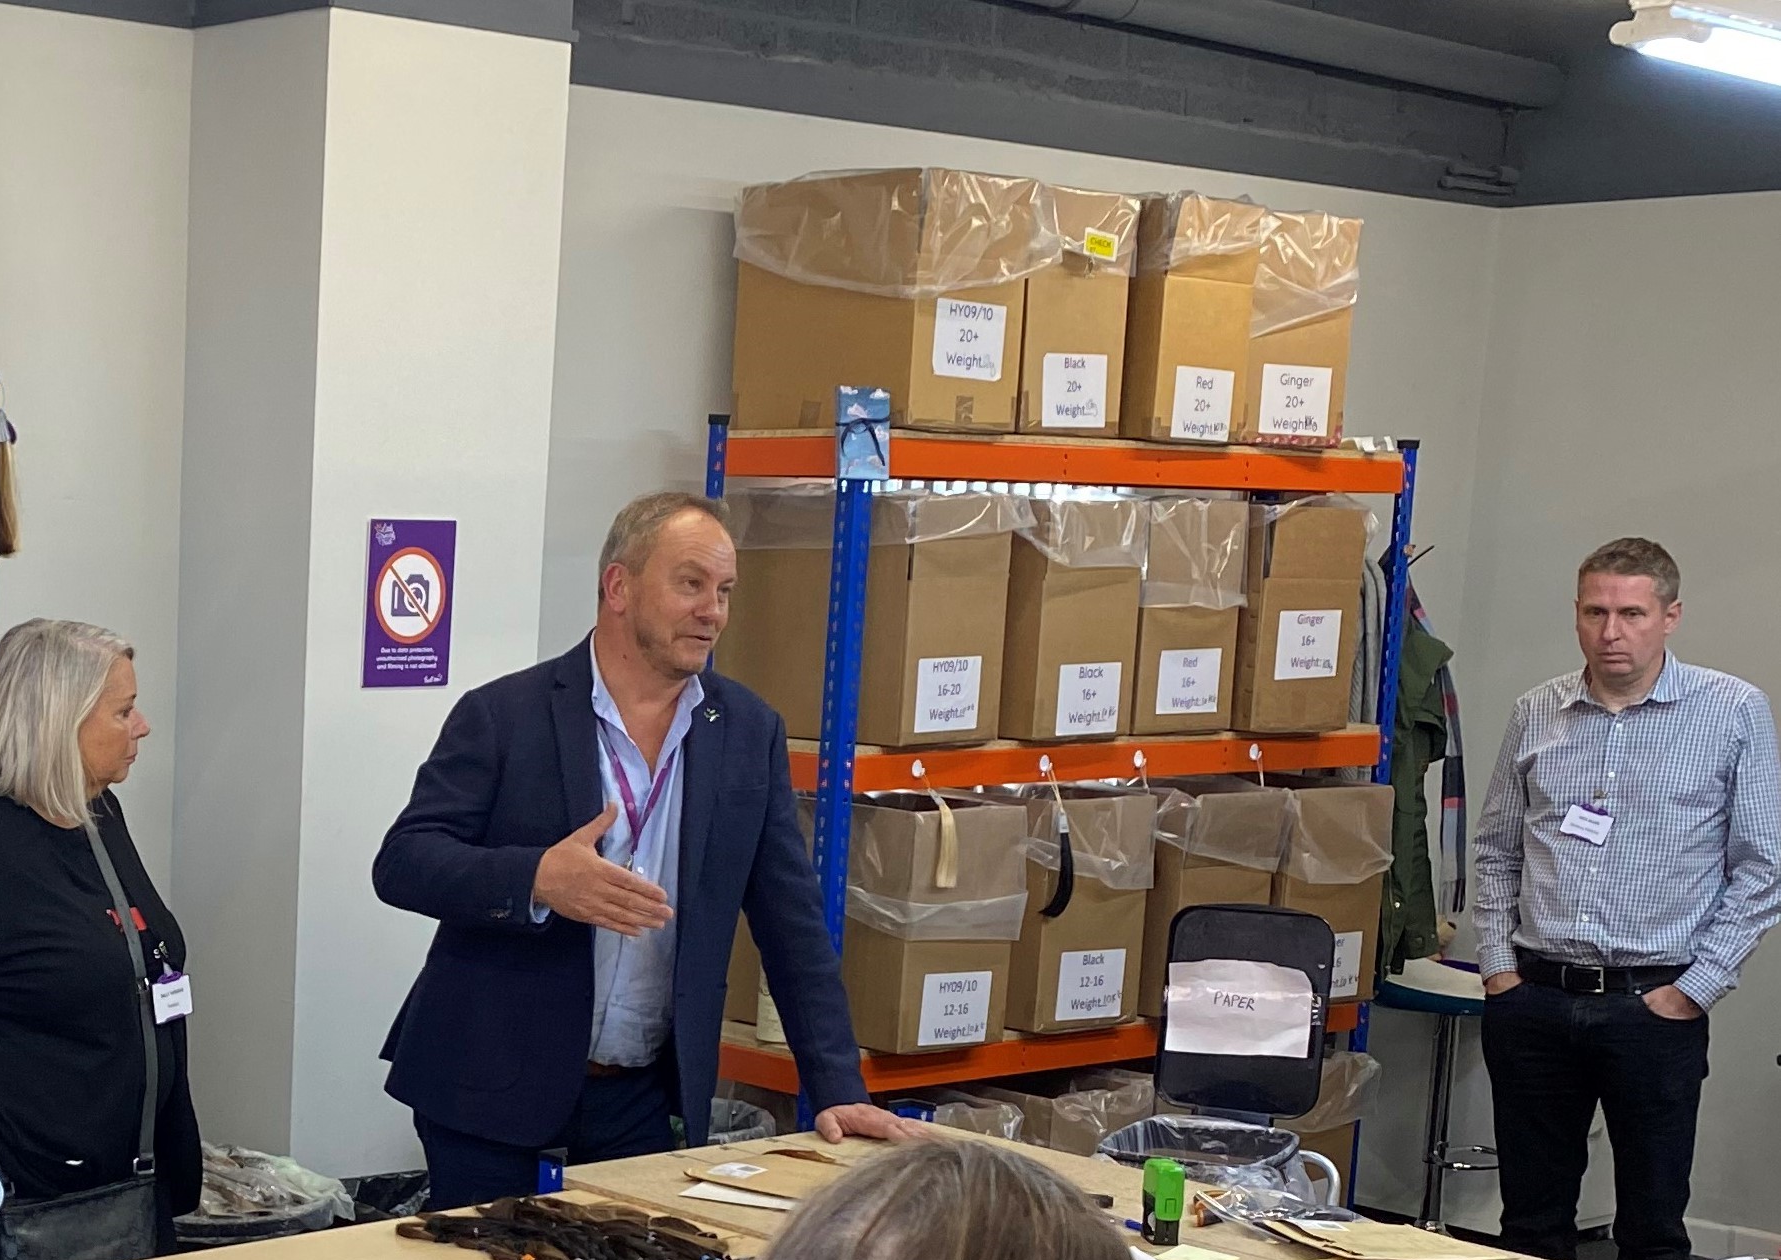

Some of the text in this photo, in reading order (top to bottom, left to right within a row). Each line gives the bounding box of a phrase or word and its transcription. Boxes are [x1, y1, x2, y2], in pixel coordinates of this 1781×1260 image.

[950, 303, 993, 321] HY09/10
[959, 329, 979, 342] 20+
[1064, 358, 1085, 368] Black
[1067, 381, 1081, 392] 20+
[1196, 376, 1213, 389] Red
[1280, 373, 1314, 389] Ginger
[1194, 399, 1211, 412] 20+
[1285, 396, 1304, 408] 20+
[1297, 614, 1324, 627] Ginger
[1302, 635, 1315, 646] 16+
[933, 659, 968, 673] HY09/10
[1183, 657, 1198, 667] Red
[1079, 666, 1104, 679] Black
[1182, 677, 1195, 687] 16+
[938, 683, 961, 696] 16-20
[1082, 689, 1096, 701] 16+
[1083, 953, 1104, 965] Black
[939, 980, 978, 994] HY09/10
[1080, 975, 1104, 988] 12-16
[1213, 990, 1255, 1011] PAPER
[944, 1003, 969, 1016] 12-16
